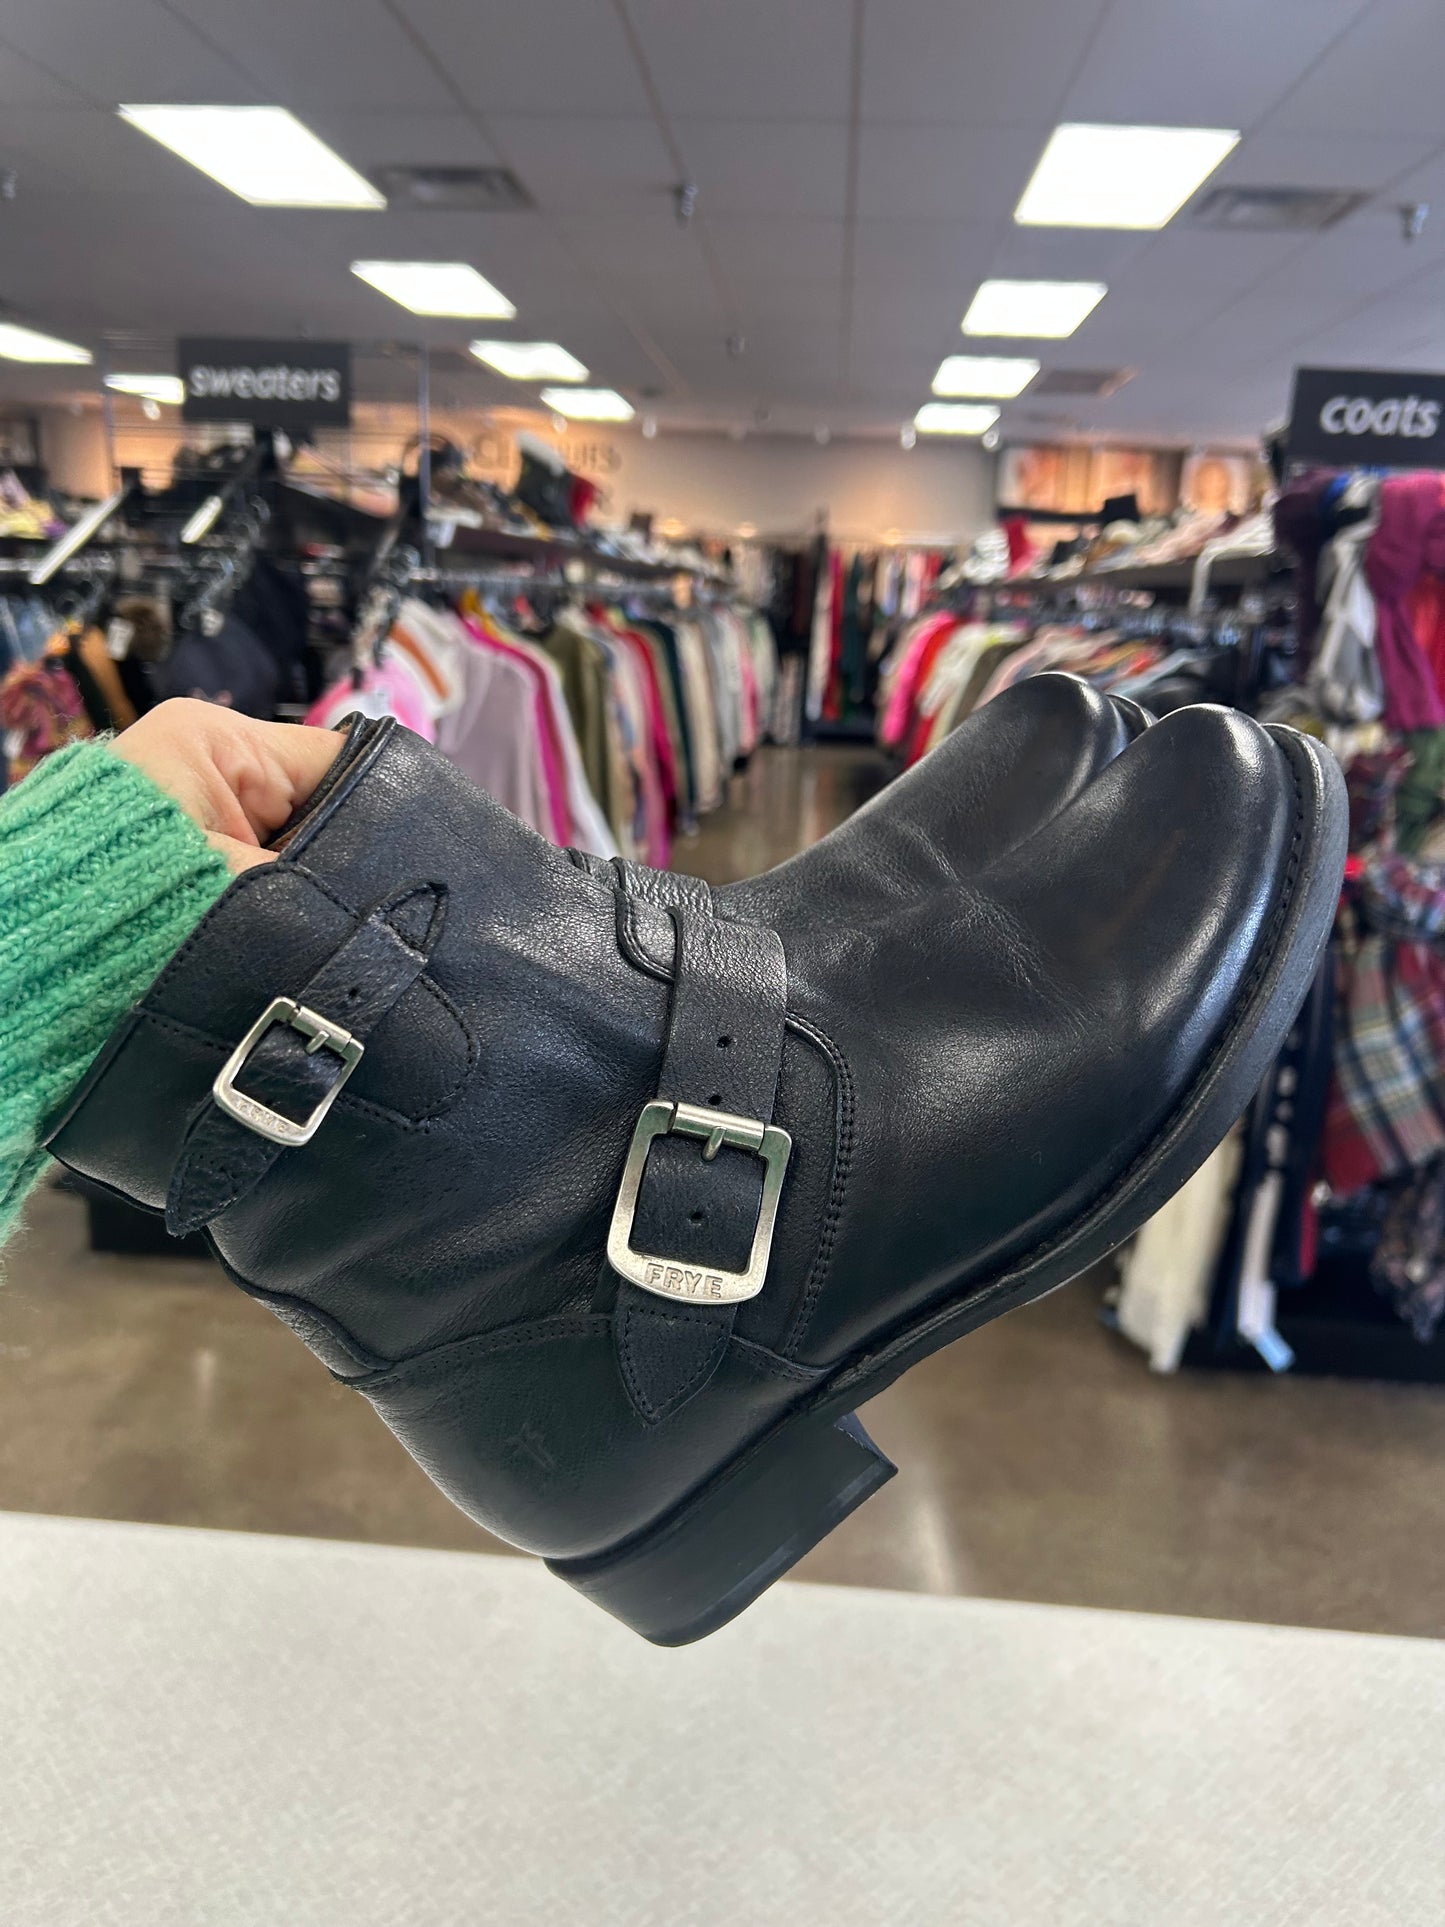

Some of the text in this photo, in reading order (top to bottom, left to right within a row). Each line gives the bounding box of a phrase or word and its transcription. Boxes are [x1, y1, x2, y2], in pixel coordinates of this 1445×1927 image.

[189, 364, 341, 402] sweaters
[1319, 394, 1441, 438] coats
[644, 1262, 723, 1298] FRYE
